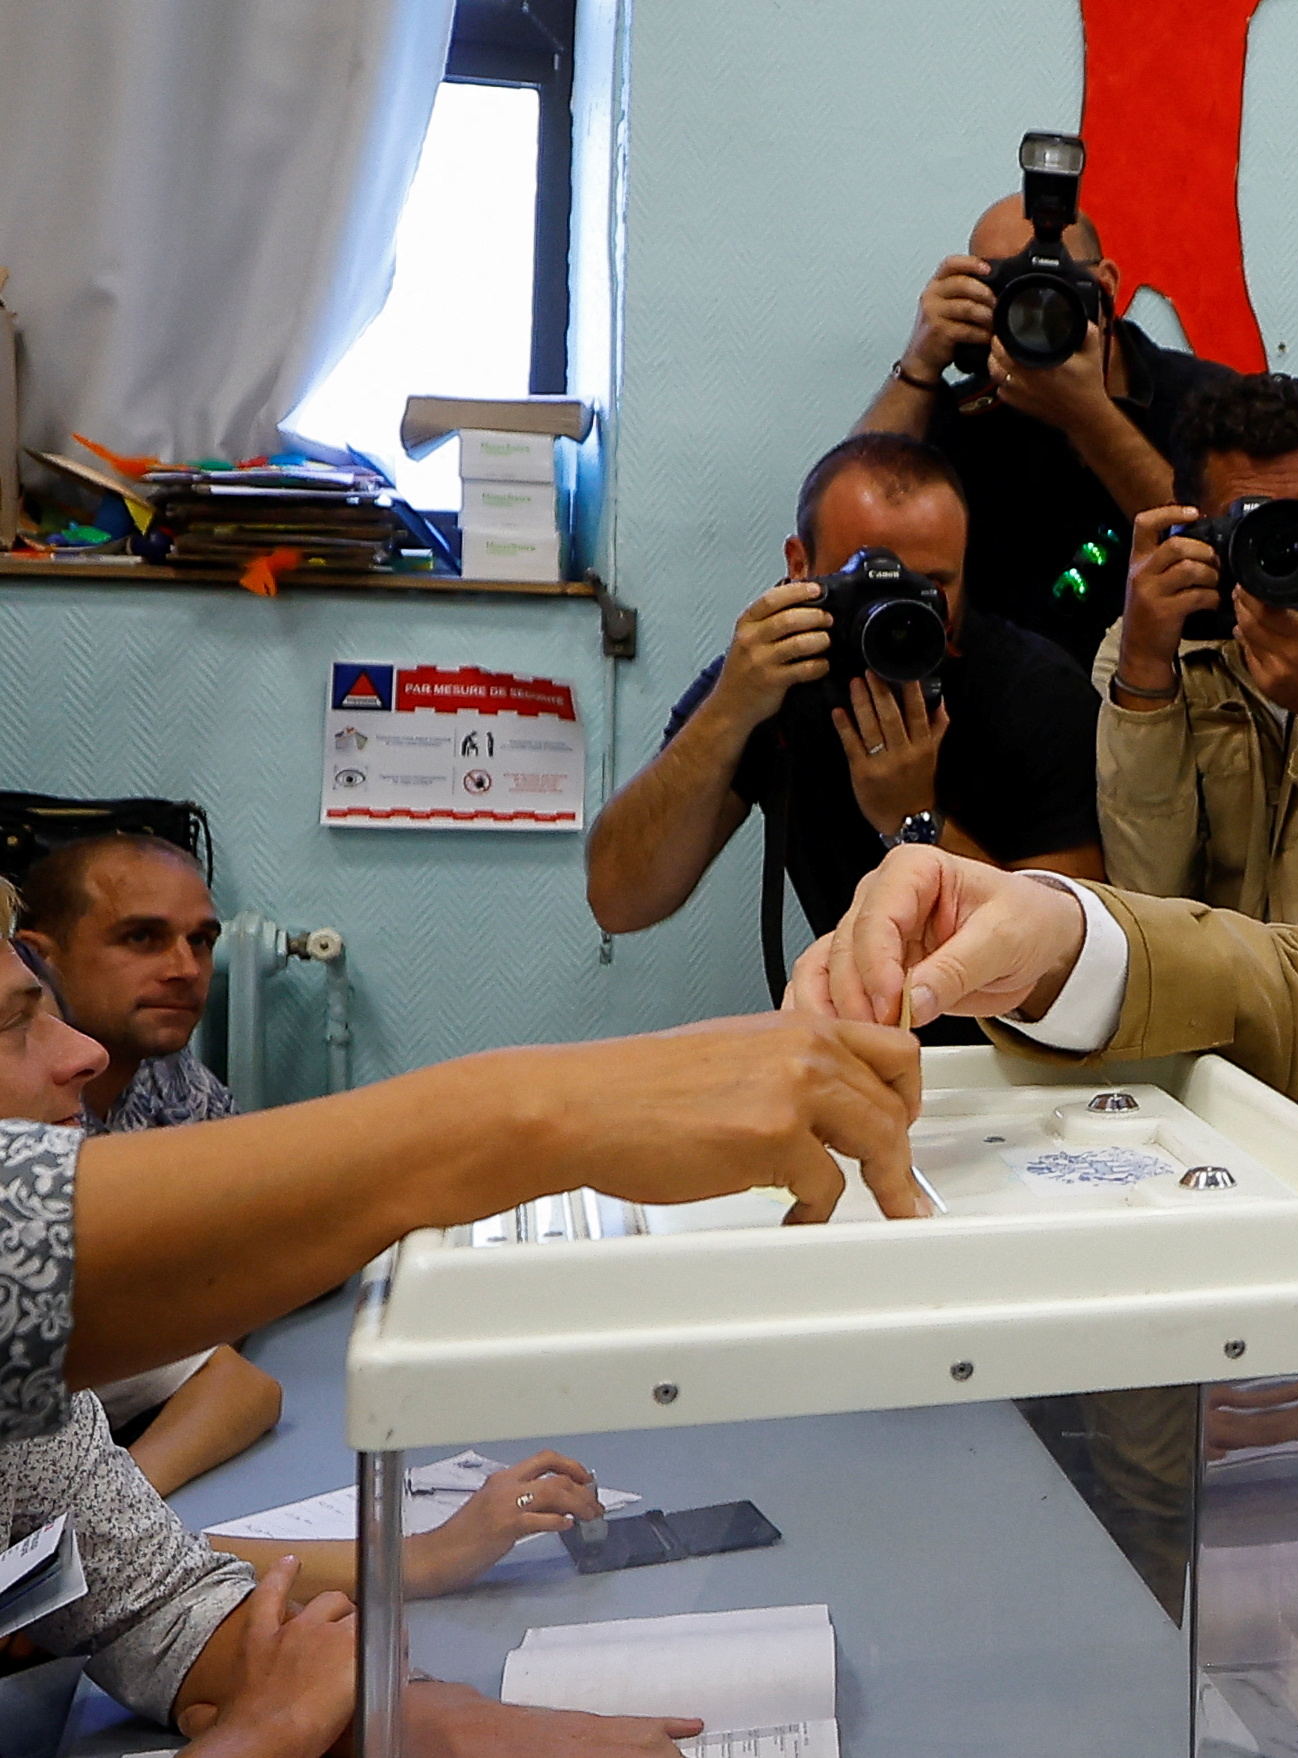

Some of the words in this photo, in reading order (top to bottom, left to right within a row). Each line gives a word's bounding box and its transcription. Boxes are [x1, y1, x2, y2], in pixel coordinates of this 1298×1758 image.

[868, 569, 900, 579] Canon
[405, 683, 432, 694] PAR
[433, 684, 486, 696] MESURE
[490, 686, 507, 697] DE
